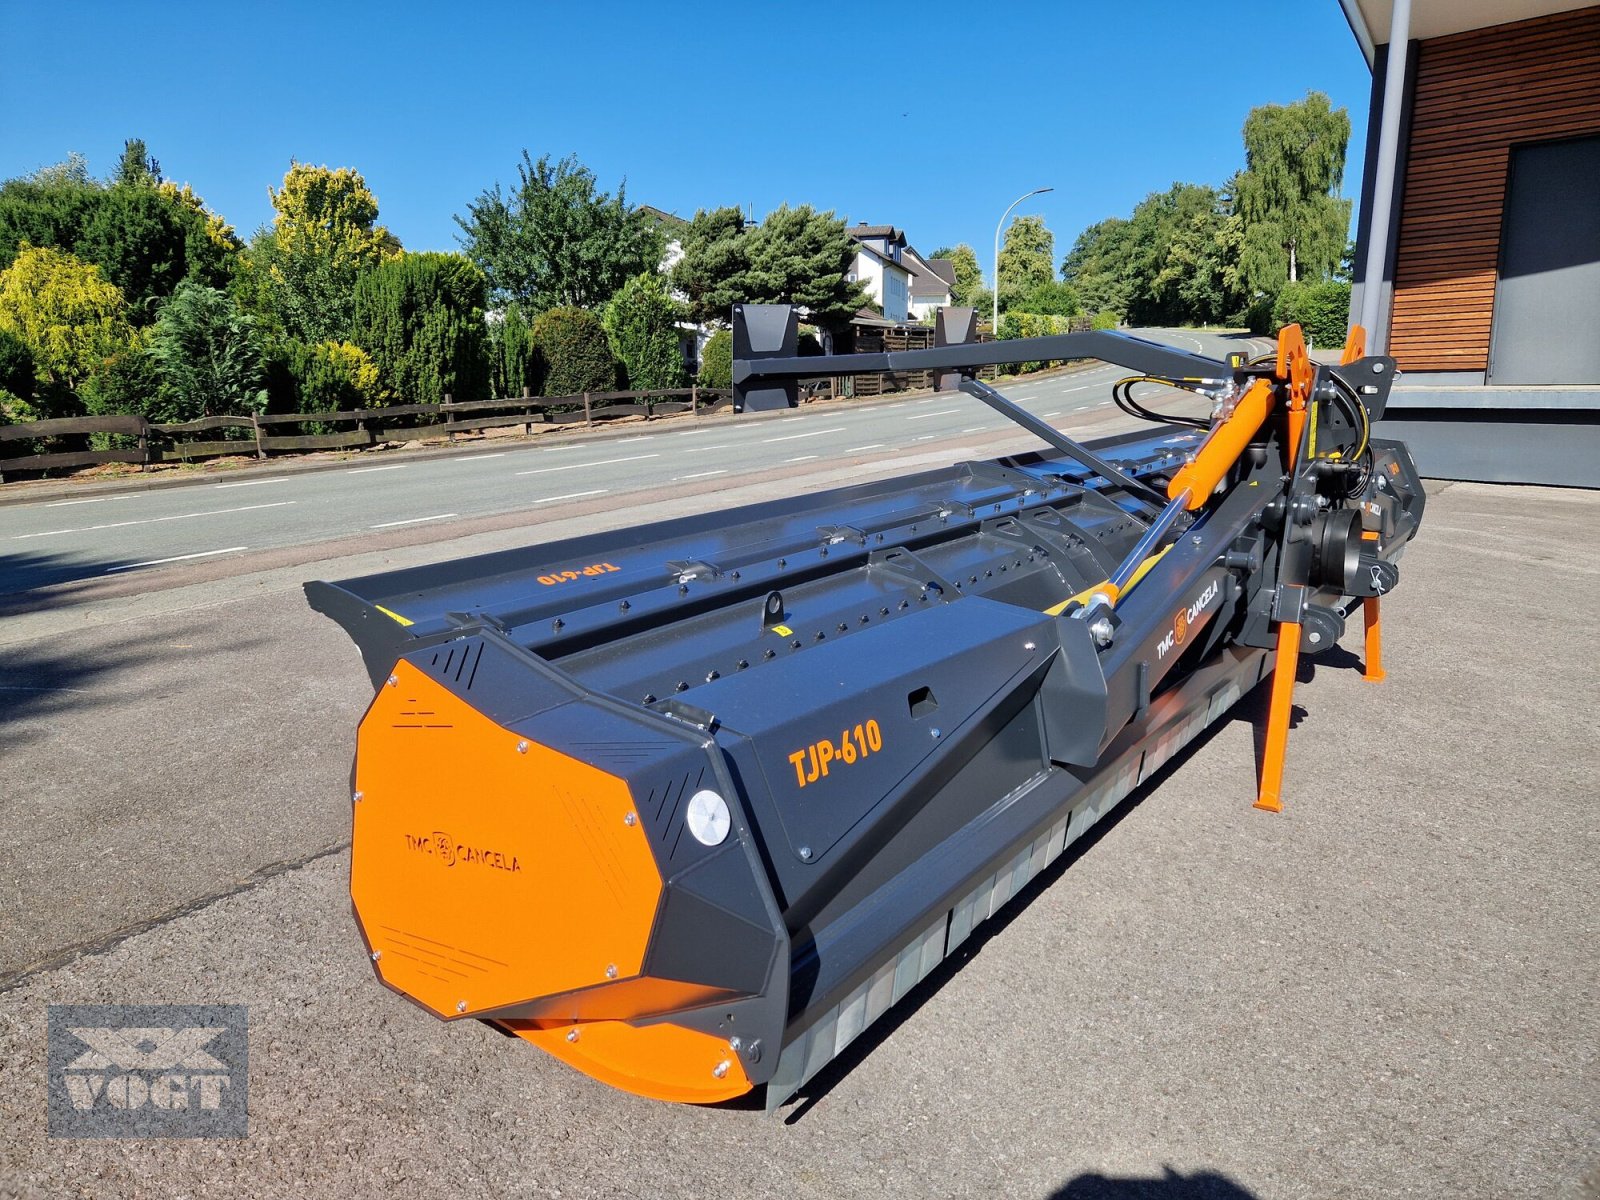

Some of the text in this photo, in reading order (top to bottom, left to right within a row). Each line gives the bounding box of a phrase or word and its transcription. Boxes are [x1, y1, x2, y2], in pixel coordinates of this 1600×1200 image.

[537, 563, 621, 585] TJP-610
[1157, 580, 1218, 659] TMC CANCELA
[788, 719, 882, 788] TJP-610
[405, 834, 521, 873] TMC CANCELA
